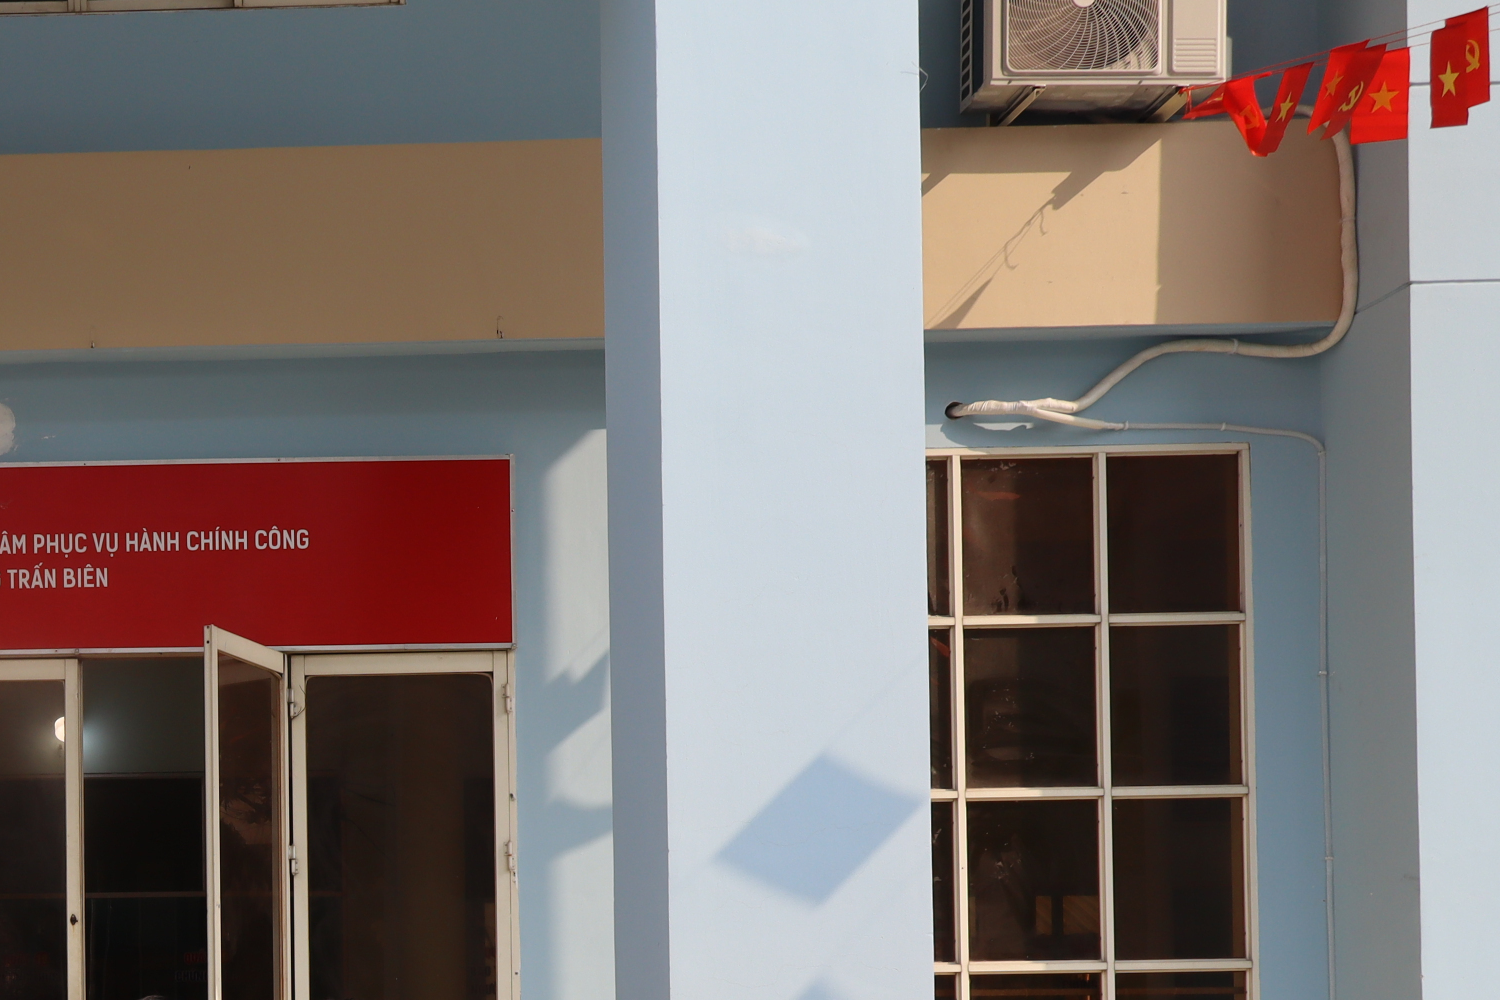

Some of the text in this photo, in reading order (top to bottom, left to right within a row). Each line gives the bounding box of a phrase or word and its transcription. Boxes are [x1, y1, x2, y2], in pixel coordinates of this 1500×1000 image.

[33, 532, 87, 558] PHỤC
[93, 532, 119, 557] VỤ
[125, 527, 180, 552] HÀNH
[186, 526, 248, 551] CHÍNH
[254, 525, 309, 549] CÔNG
[7, 562, 57, 589] TRẤN
[63, 564, 108, 588] BIÊN
